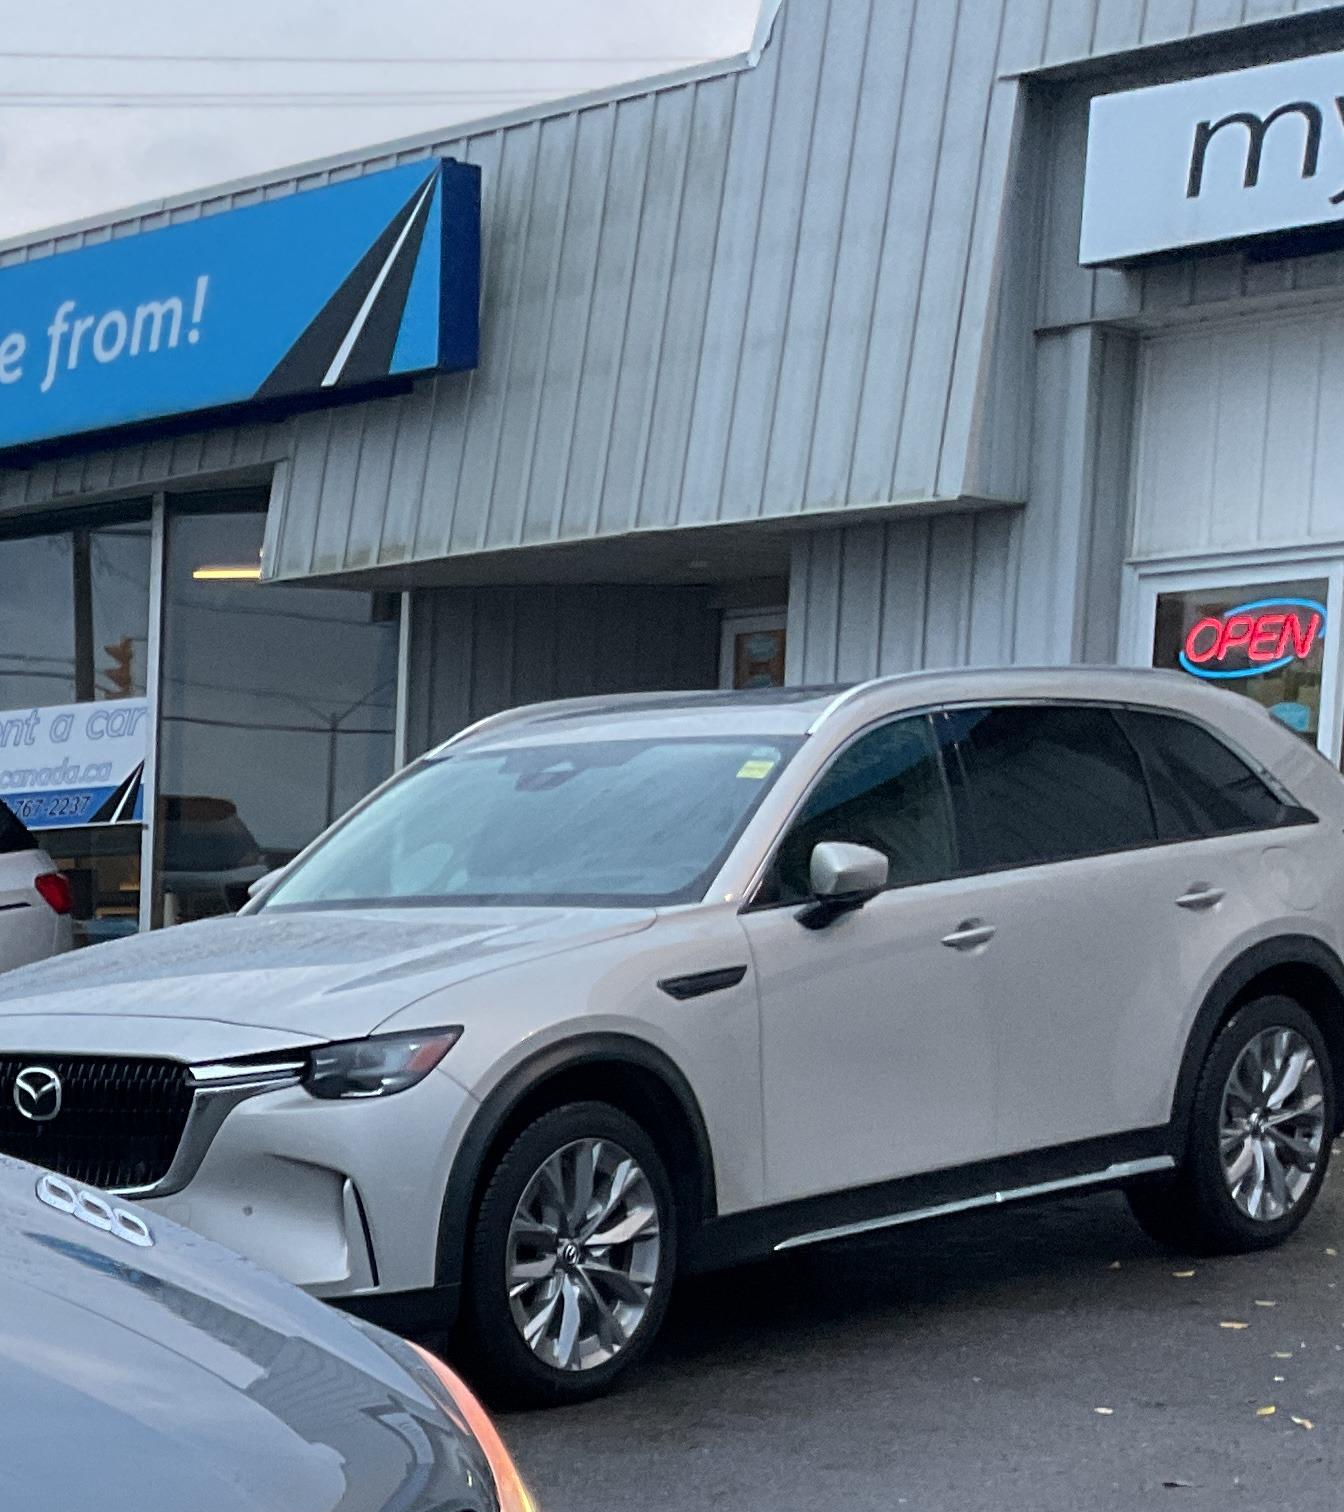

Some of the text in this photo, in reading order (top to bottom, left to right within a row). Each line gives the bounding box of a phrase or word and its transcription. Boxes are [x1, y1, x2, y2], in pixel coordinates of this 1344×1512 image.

[1186, 96, 1344, 204] m
[39, 275, 209, 393] from!
[1185, 613, 1320, 663] OPEN
[48, 713, 74, 744] a
[85, 705, 148, 741] car
